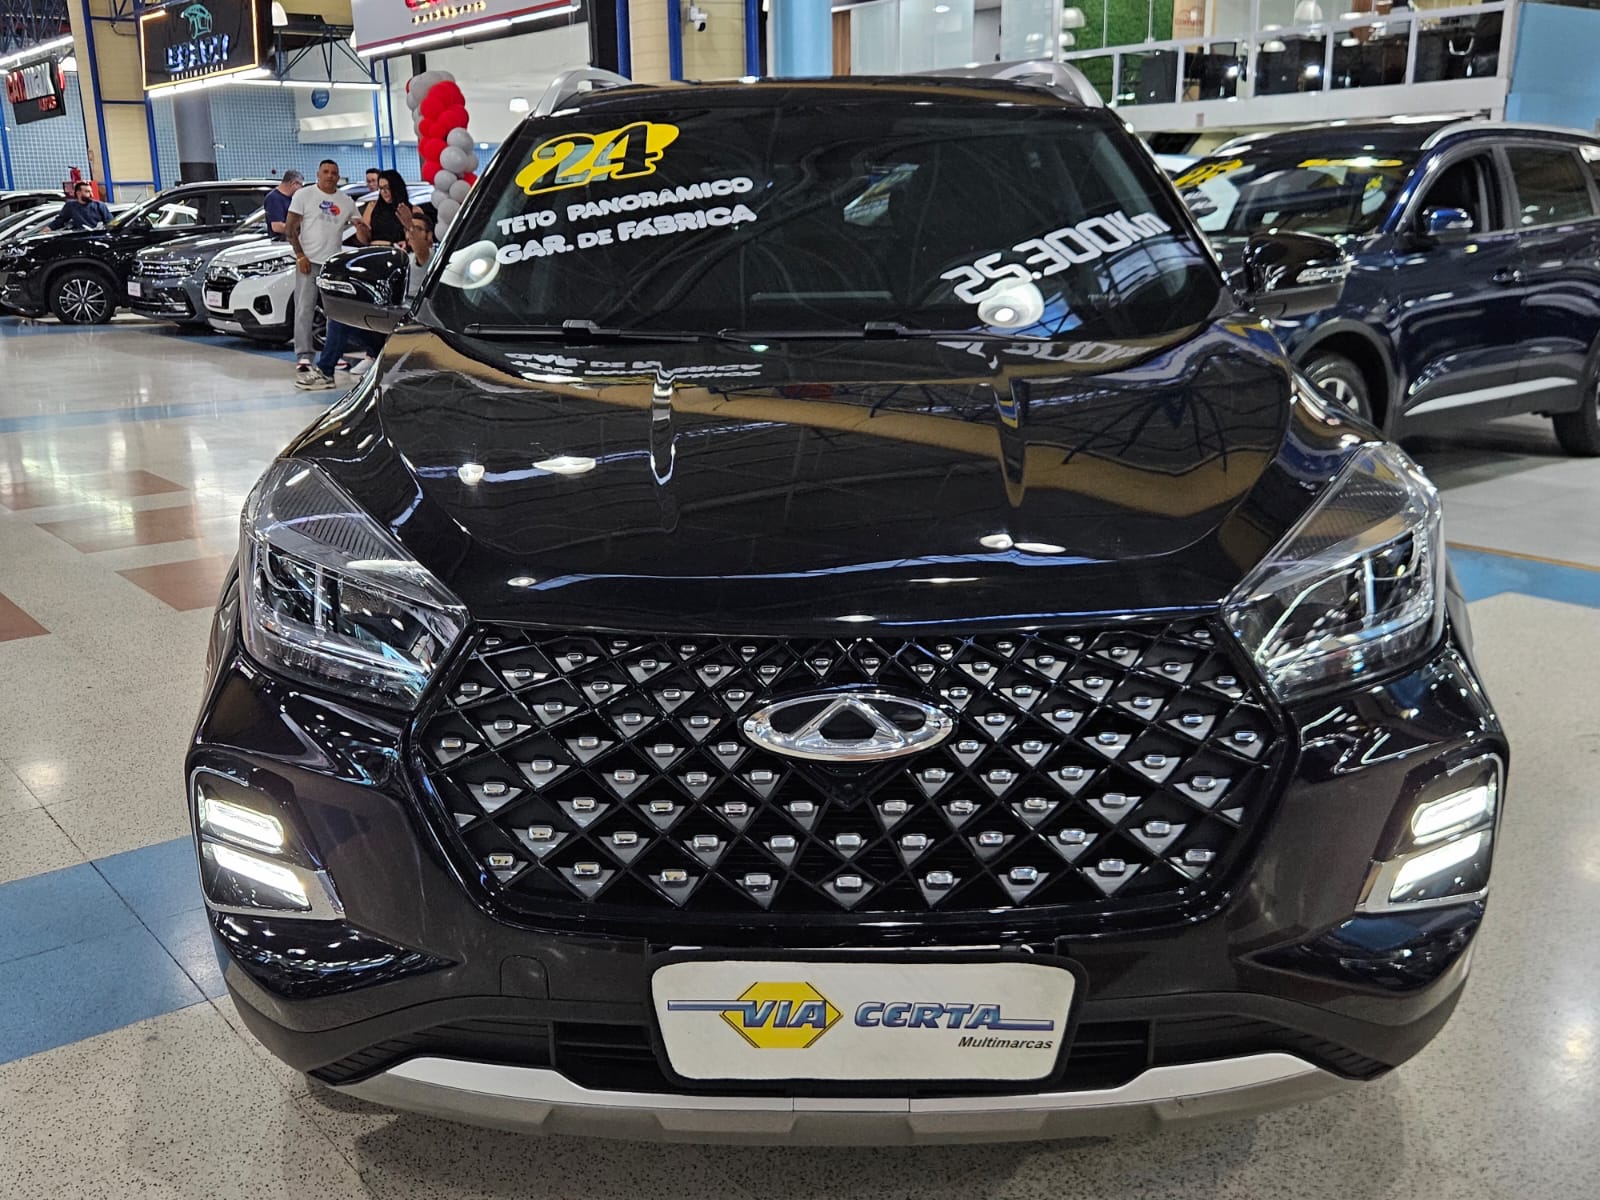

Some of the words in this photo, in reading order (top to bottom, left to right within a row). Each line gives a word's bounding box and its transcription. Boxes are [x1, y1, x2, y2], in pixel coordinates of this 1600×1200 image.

[515, 121, 680, 196] 24
[497, 210, 557, 236] TETO
[496, 234, 575, 265] GAR.
[577, 228, 614, 249] DE
[742, 1000, 828, 1029] VIA
[853, 1001, 1001, 1030] CERTA
[957, 1035, 1054, 1050] Multimarcas
